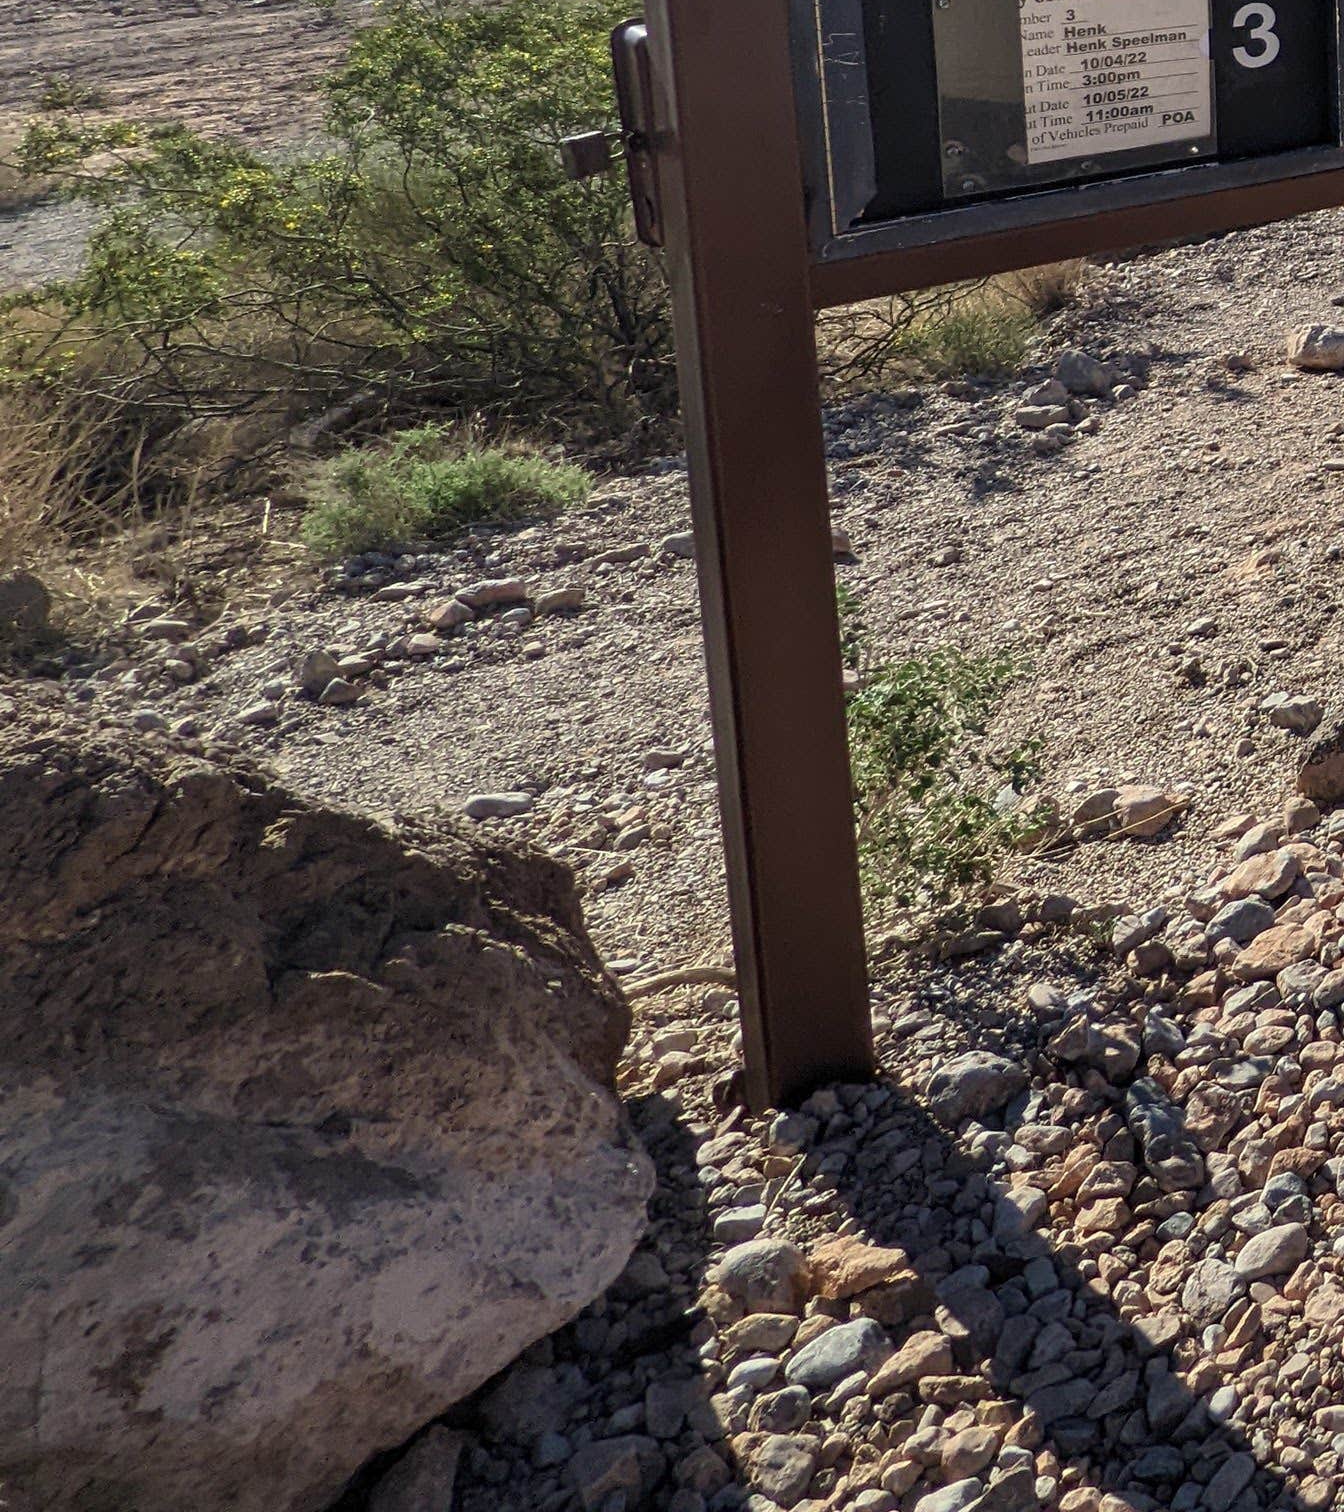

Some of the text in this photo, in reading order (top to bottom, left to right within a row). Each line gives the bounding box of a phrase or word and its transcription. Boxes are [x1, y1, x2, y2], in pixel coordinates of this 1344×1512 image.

[1065, 9, 1076, 21] 3
[1063, 23, 1107, 38] Henk
[1066, 38, 1108, 54] Henk
[1112, 31, 1188, 49] Speelman
[1232, 2, 1280, 68] 3
[1036, 63, 1066, 77] Date
[1081, 52, 1148, 72] 10/04/22
[1038, 78, 1071, 92] Time
[1082, 70, 1141, 87] 3:00pm
[1040, 99, 1070, 113] Date
[1083, 86, 1150, 105] 10/05/22
[1041, 114, 1074, 128] Time
[1086, 104, 1154, 122] 11:00am
[1031, 131, 1046, 146] of
[1048, 125, 1101, 142] Vehicles
[1104, 118, 1149, 135] Prepaid
[1162, 111, 1196, 125] POA
